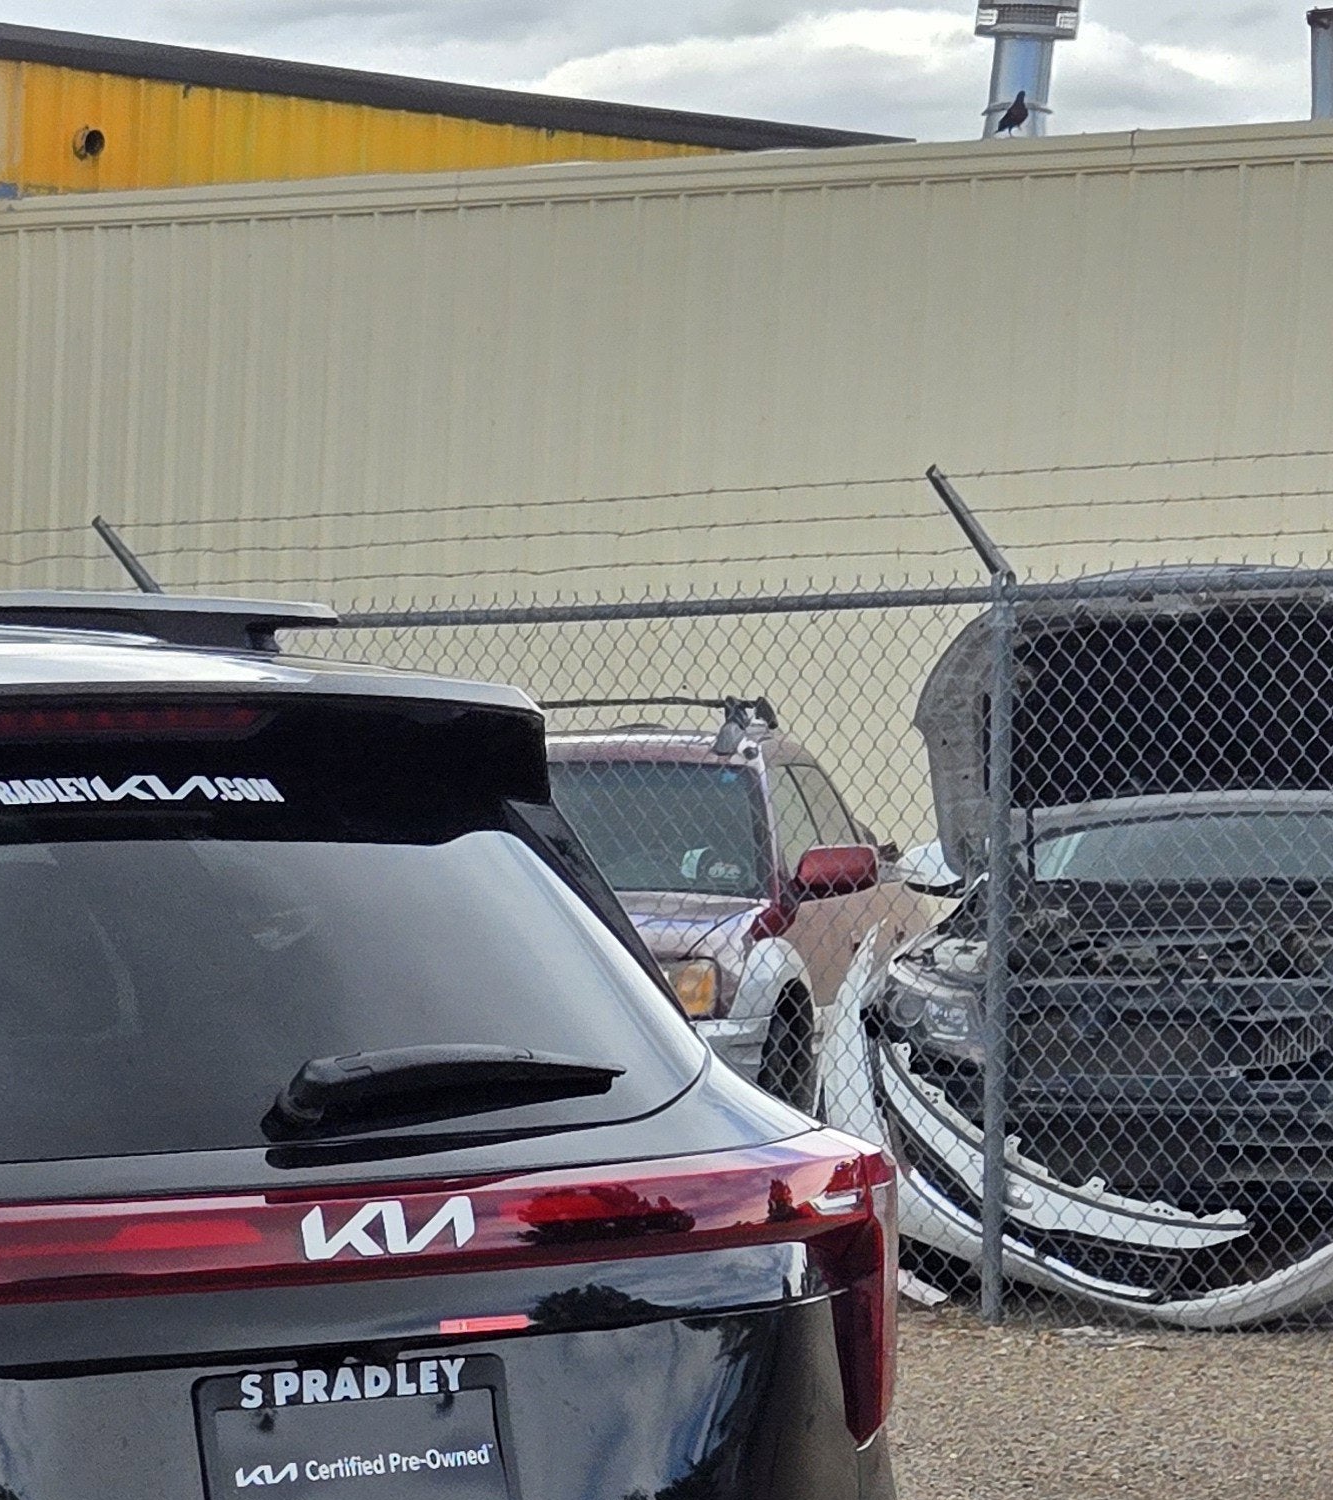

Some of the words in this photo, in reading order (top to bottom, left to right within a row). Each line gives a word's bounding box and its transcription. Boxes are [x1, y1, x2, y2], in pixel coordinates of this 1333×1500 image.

[301, 1196, 475, 1260] KIA
[240, 1358, 466, 1409] SPRADLEY
[235, 1462, 298, 1488] KIA
[305, 1456, 386, 1482] Certified
[389, 1444, 491, 1473] Pre-Owned
